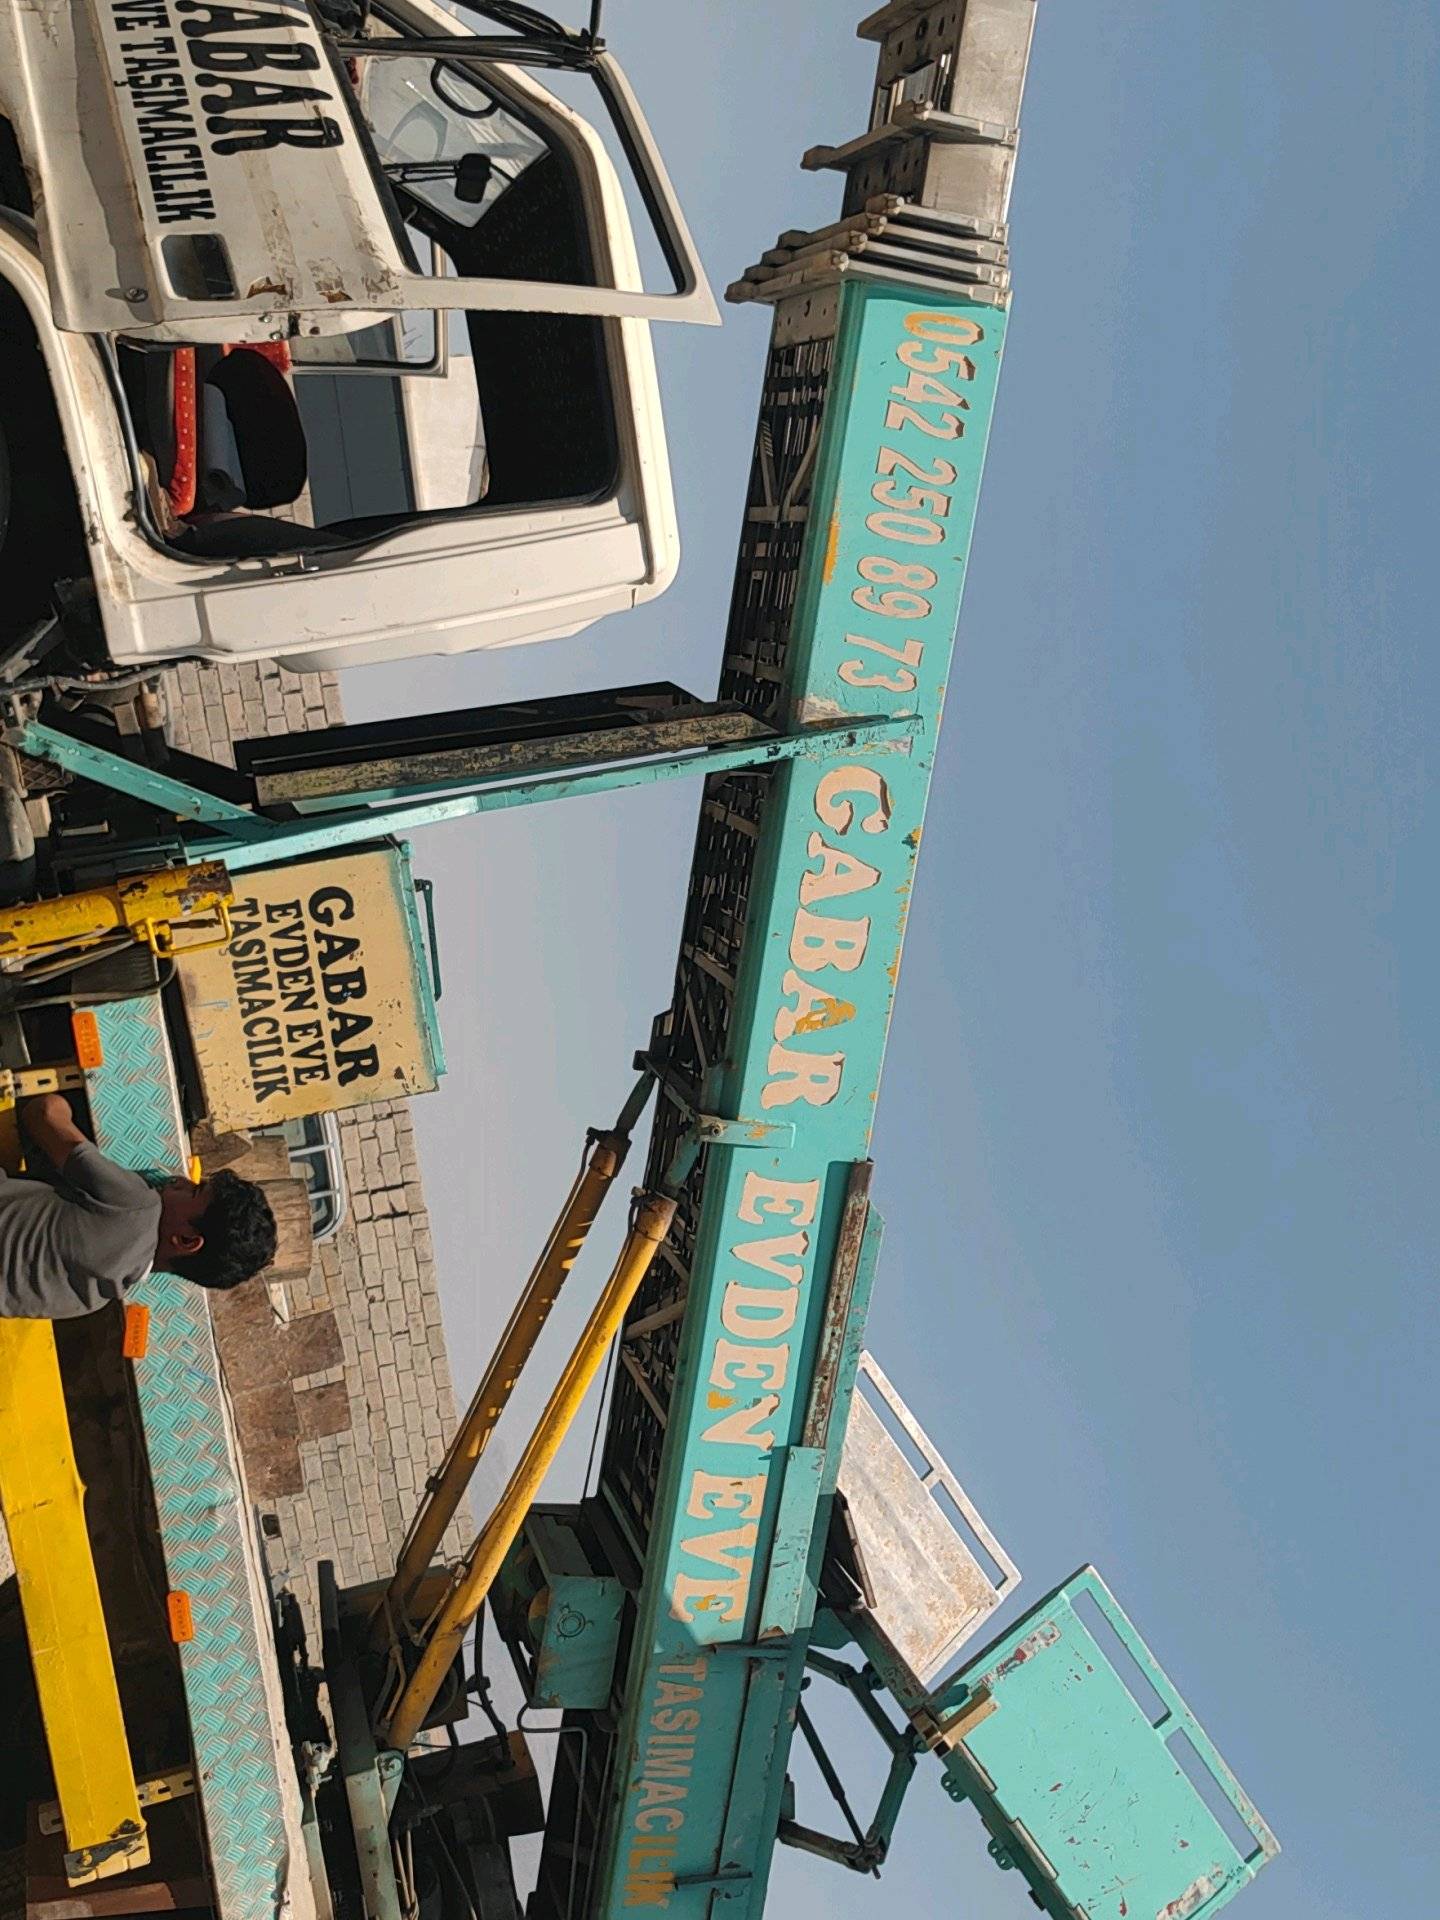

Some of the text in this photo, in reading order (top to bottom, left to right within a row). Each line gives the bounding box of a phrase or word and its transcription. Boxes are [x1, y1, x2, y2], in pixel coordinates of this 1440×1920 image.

[111, 0, 217, 224] VE TAŞIMACILIK
[175, 0, 344, 156] ABAR
[837, 311, 985, 693] 0542 250 89 73
[265, 899, 330, 1086] EVDEN EVE
[308, 886, 380, 1087] GABAR
[761, 765, 892, 1109] GABAR
[699, 1171, 820, 1451] EVDEN
[668, 1470, 768, 1624] EVE
